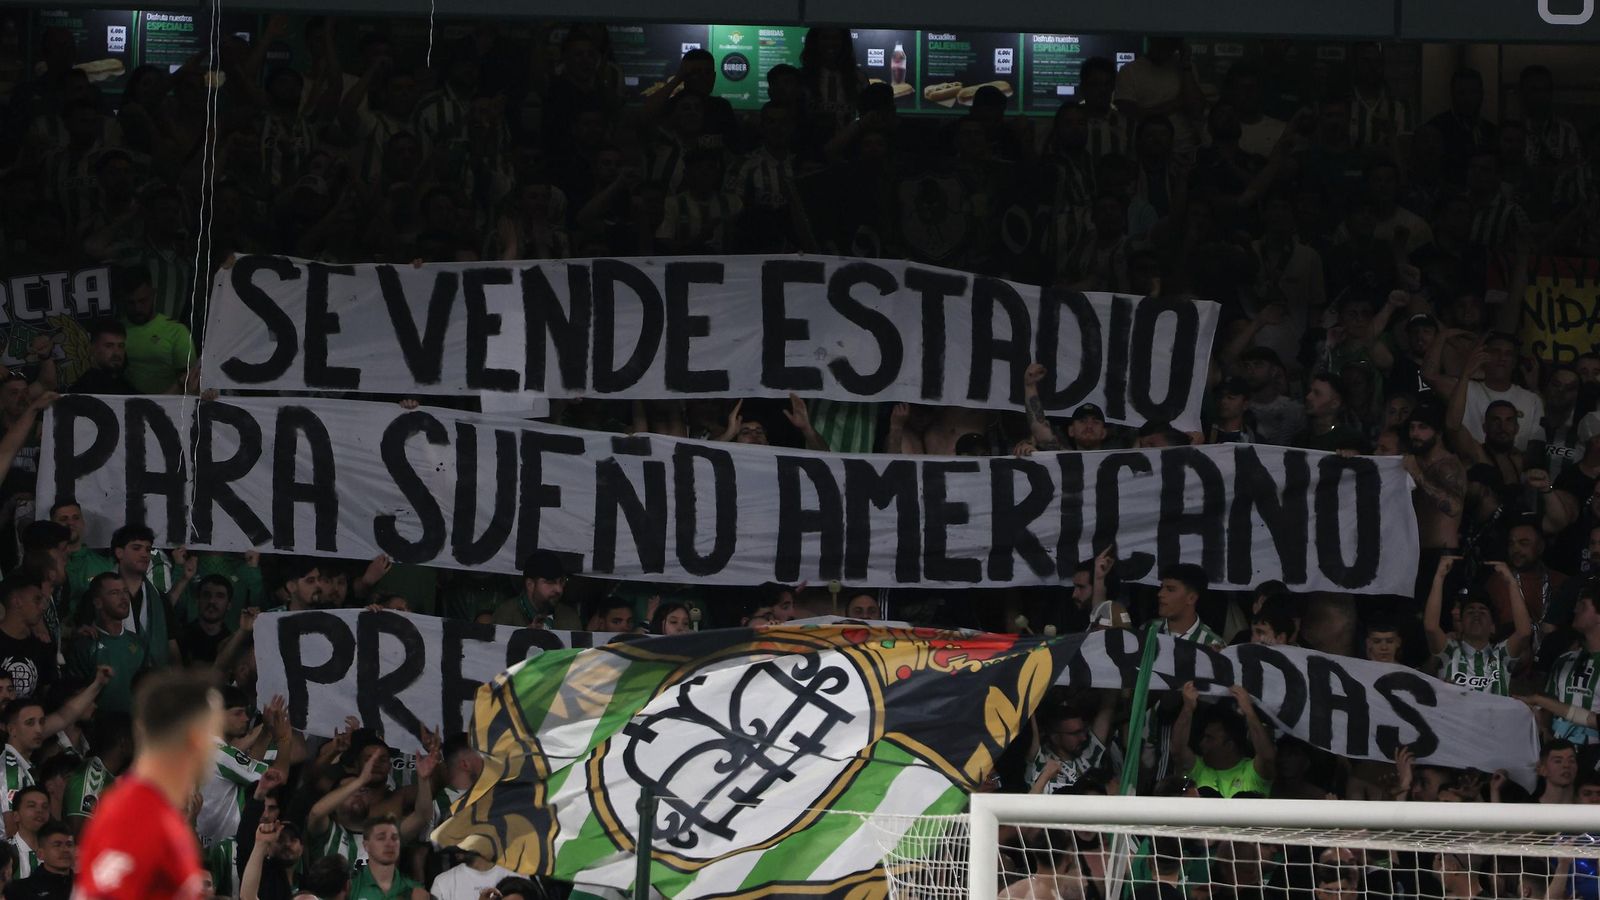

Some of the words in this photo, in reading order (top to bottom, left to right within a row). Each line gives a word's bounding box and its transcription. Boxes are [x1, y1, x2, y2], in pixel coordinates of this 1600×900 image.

[146, 13, 168, 21] Disfruta
[169, 14, 192, 22] nuestros
[146, 21, 194, 31] ESPECIALES
[1032, 35, 1055, 43] Disfruta
[928, 41, 970, 50] CALIENTES
[1032, 43, 1081, 53] ESPECIALES
[723, 63, 747, 71] BURGER
[220, 254, 361, 389] SE
[374, 258, 729, 393] VENDE
[762, 260, 1198, 427] ESTADIO
[53, 394, 338, 551] PARA
[374, 411, 737, 576] SUEÑO
[775, 445, 1381, 589] AMERICANO
